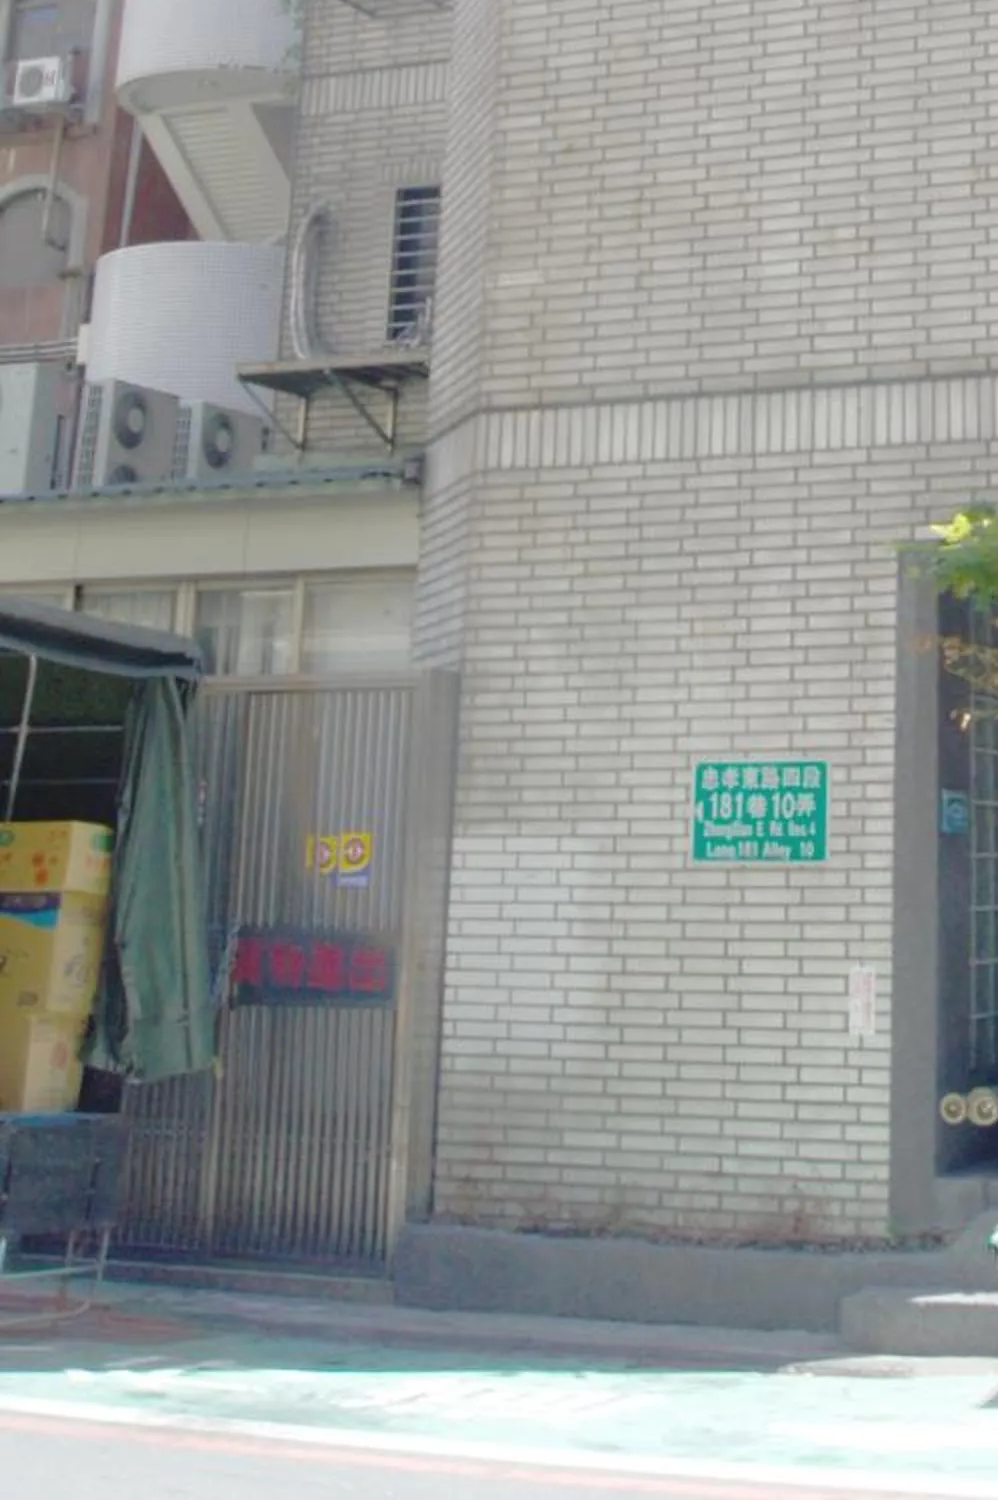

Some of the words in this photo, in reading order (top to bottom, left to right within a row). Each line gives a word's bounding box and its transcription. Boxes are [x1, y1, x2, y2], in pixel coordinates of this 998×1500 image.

[701, 765, 820, 790] 忠孝東路四段
